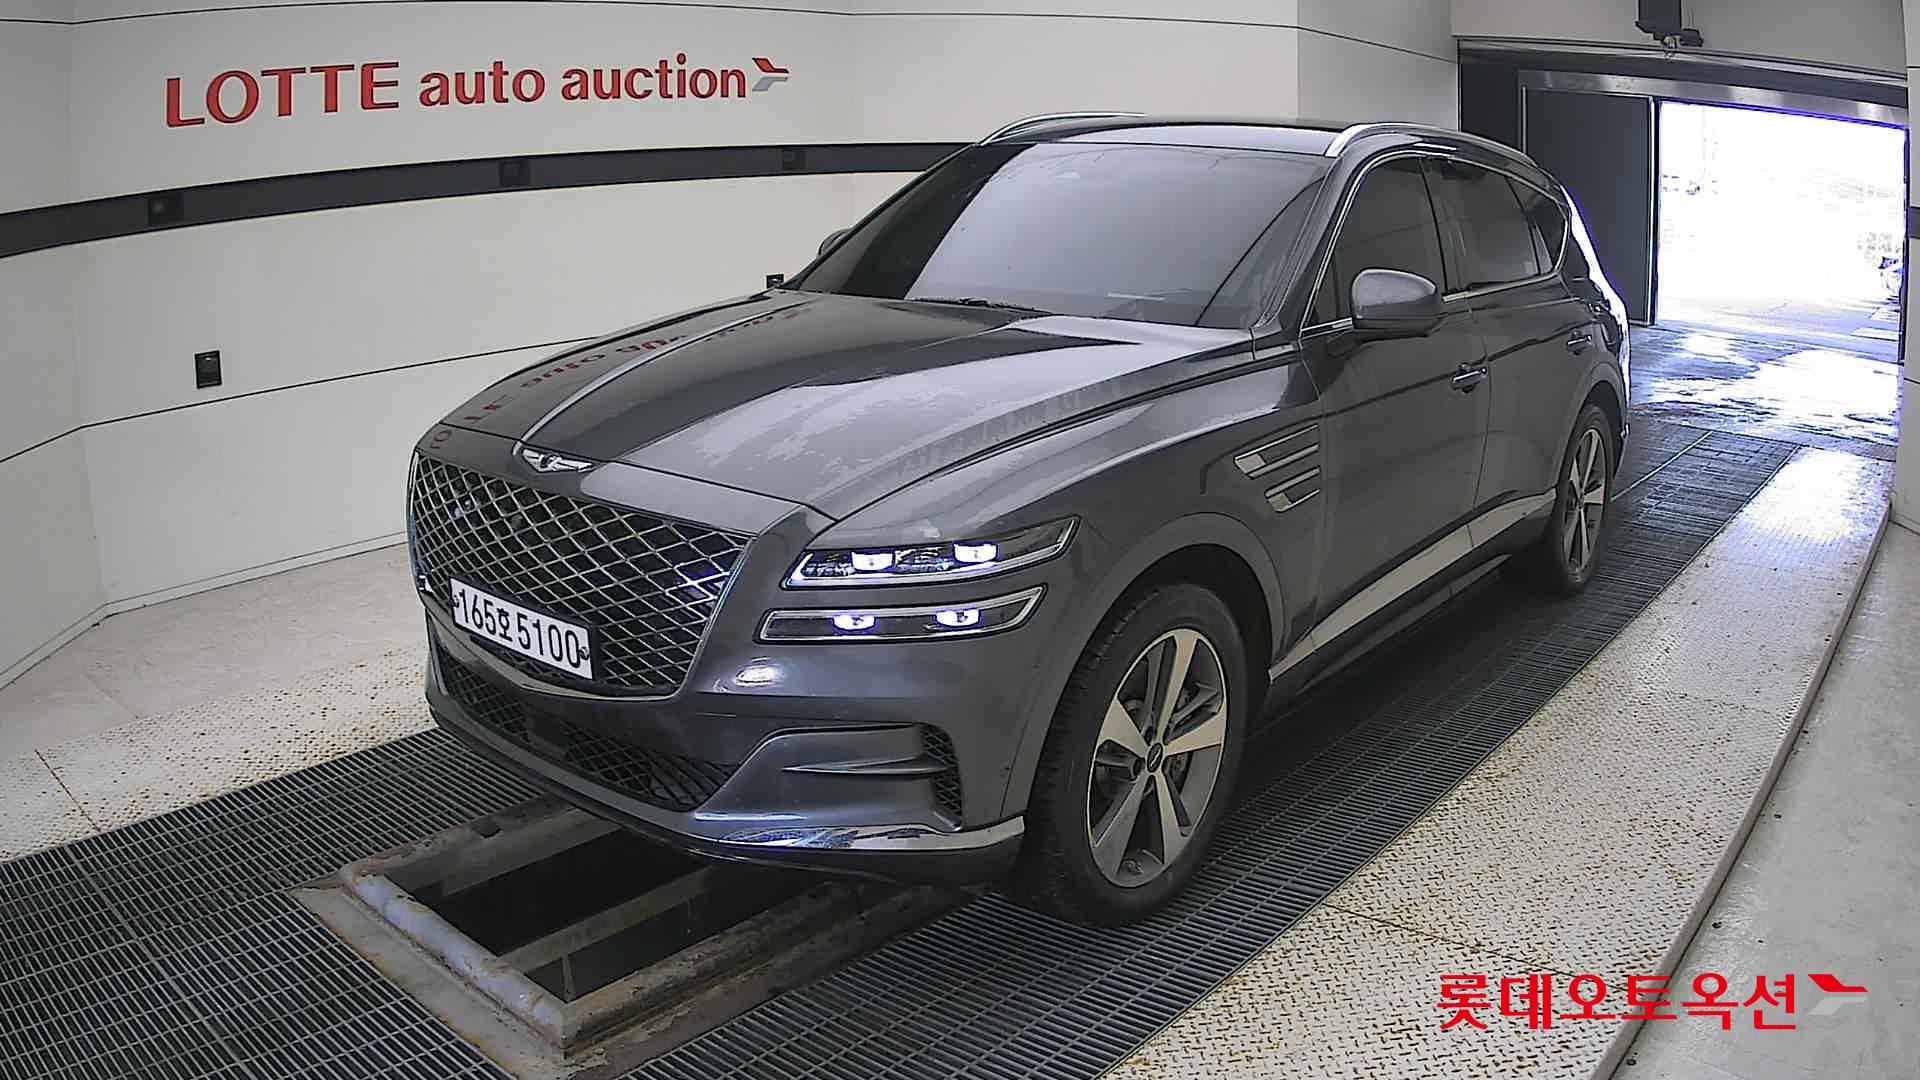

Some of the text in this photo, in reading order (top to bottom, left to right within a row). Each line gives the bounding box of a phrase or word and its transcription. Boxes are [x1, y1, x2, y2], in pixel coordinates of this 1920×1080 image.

[166, 52, 748, 128] LOTTE auto auction
